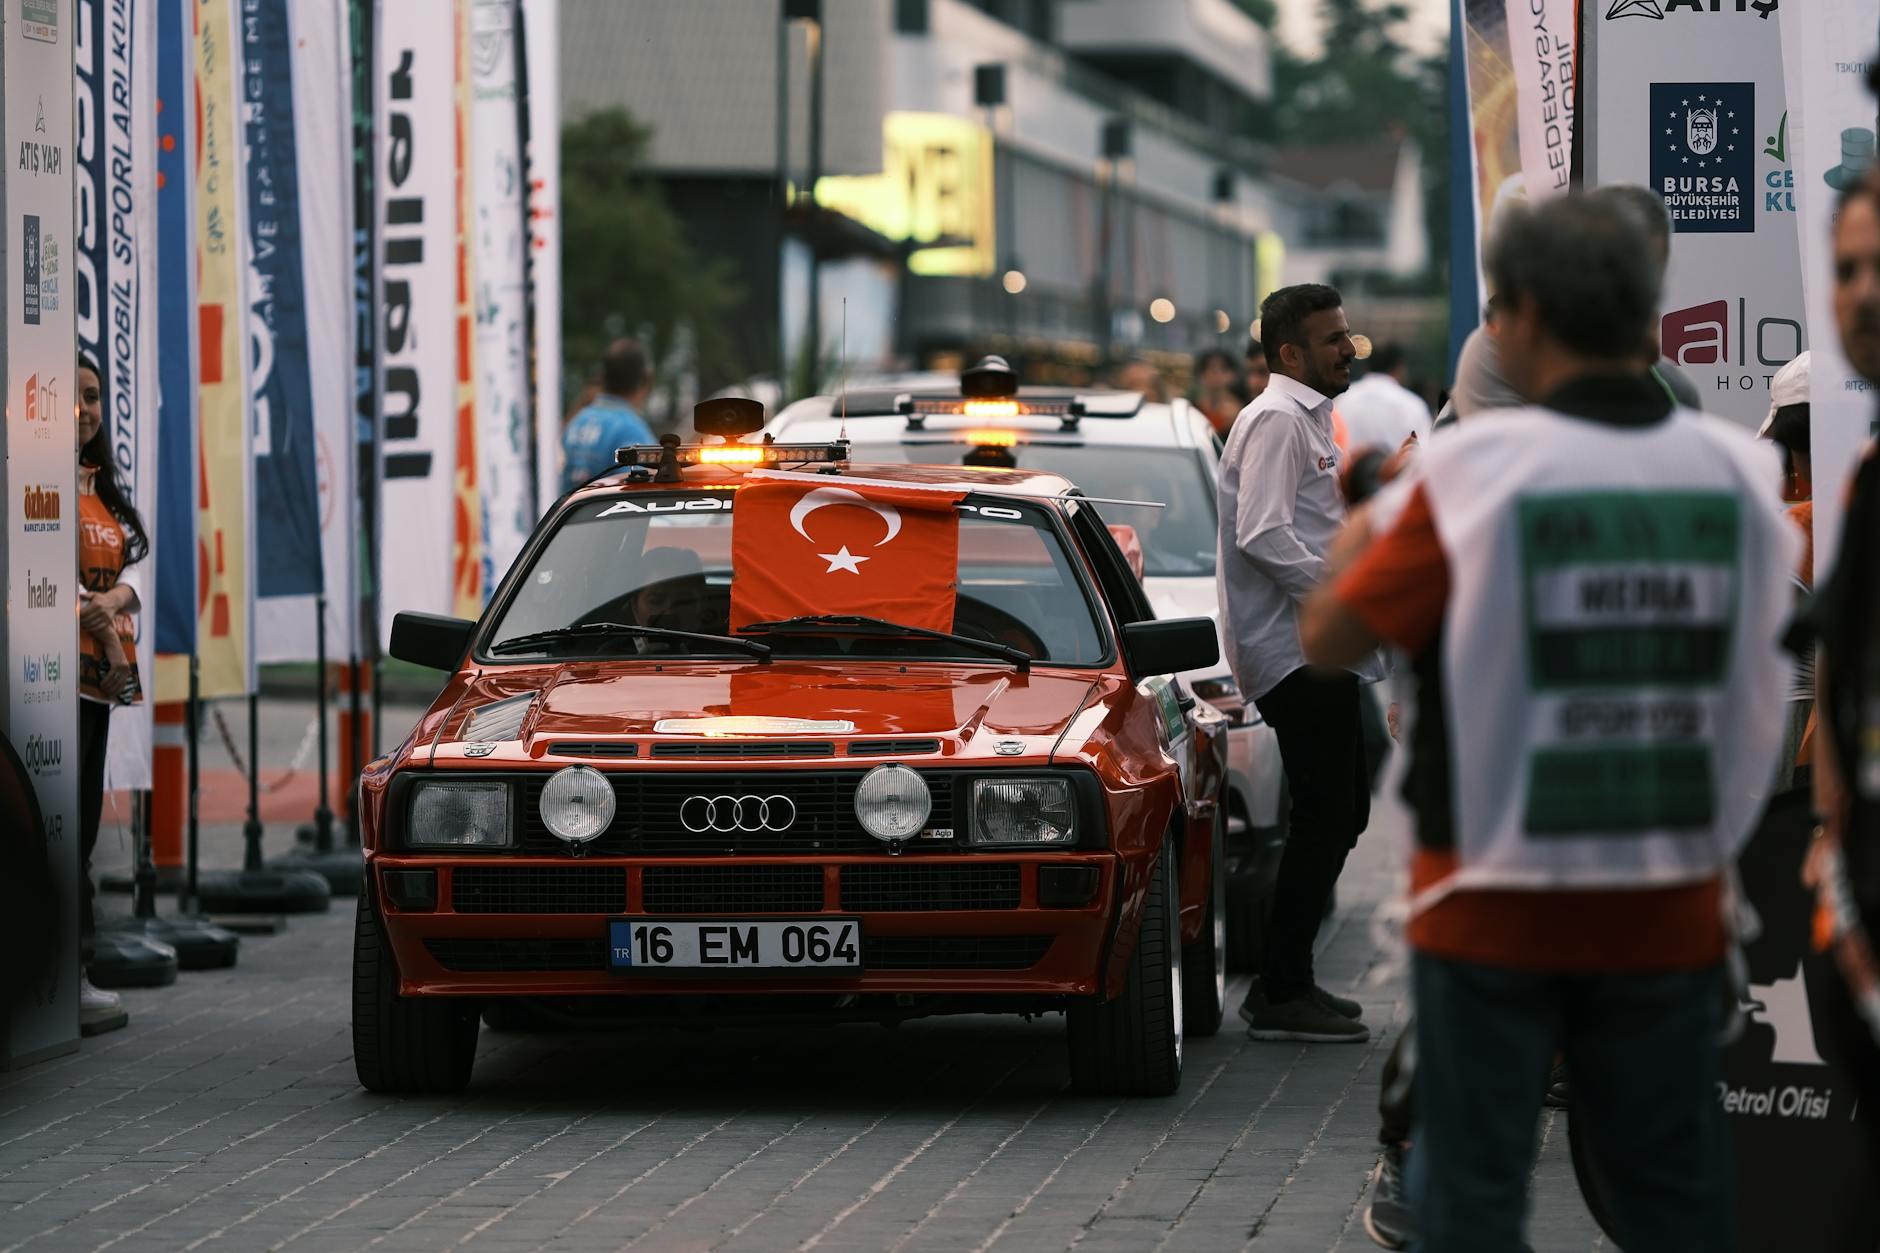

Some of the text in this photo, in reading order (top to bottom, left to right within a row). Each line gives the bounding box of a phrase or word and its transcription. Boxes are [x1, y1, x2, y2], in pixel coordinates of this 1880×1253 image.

[19, 141, 61, 177] ATIŞ YAPI
[112, 69, 132, 265] SPORLARI
[1664, 177, 1739, 193] BURSA
[1665, 193, 1739, 207] BÜYÜKŞEHİR
[1669, 207, 1740, 220] ELEDİYESİ
[257, 221, 278, 259] VE
[111, 279, 132, 471] OTOMOBİL
[25, 485, 60, 520] özhan
[27, 569, 57, 609] İnallar
[23, 654, 41, 683] Mavi
[614, 925, 857, 964] TR 16 EM 064
[1777, 1085, 1832, 1119] Ofisi
